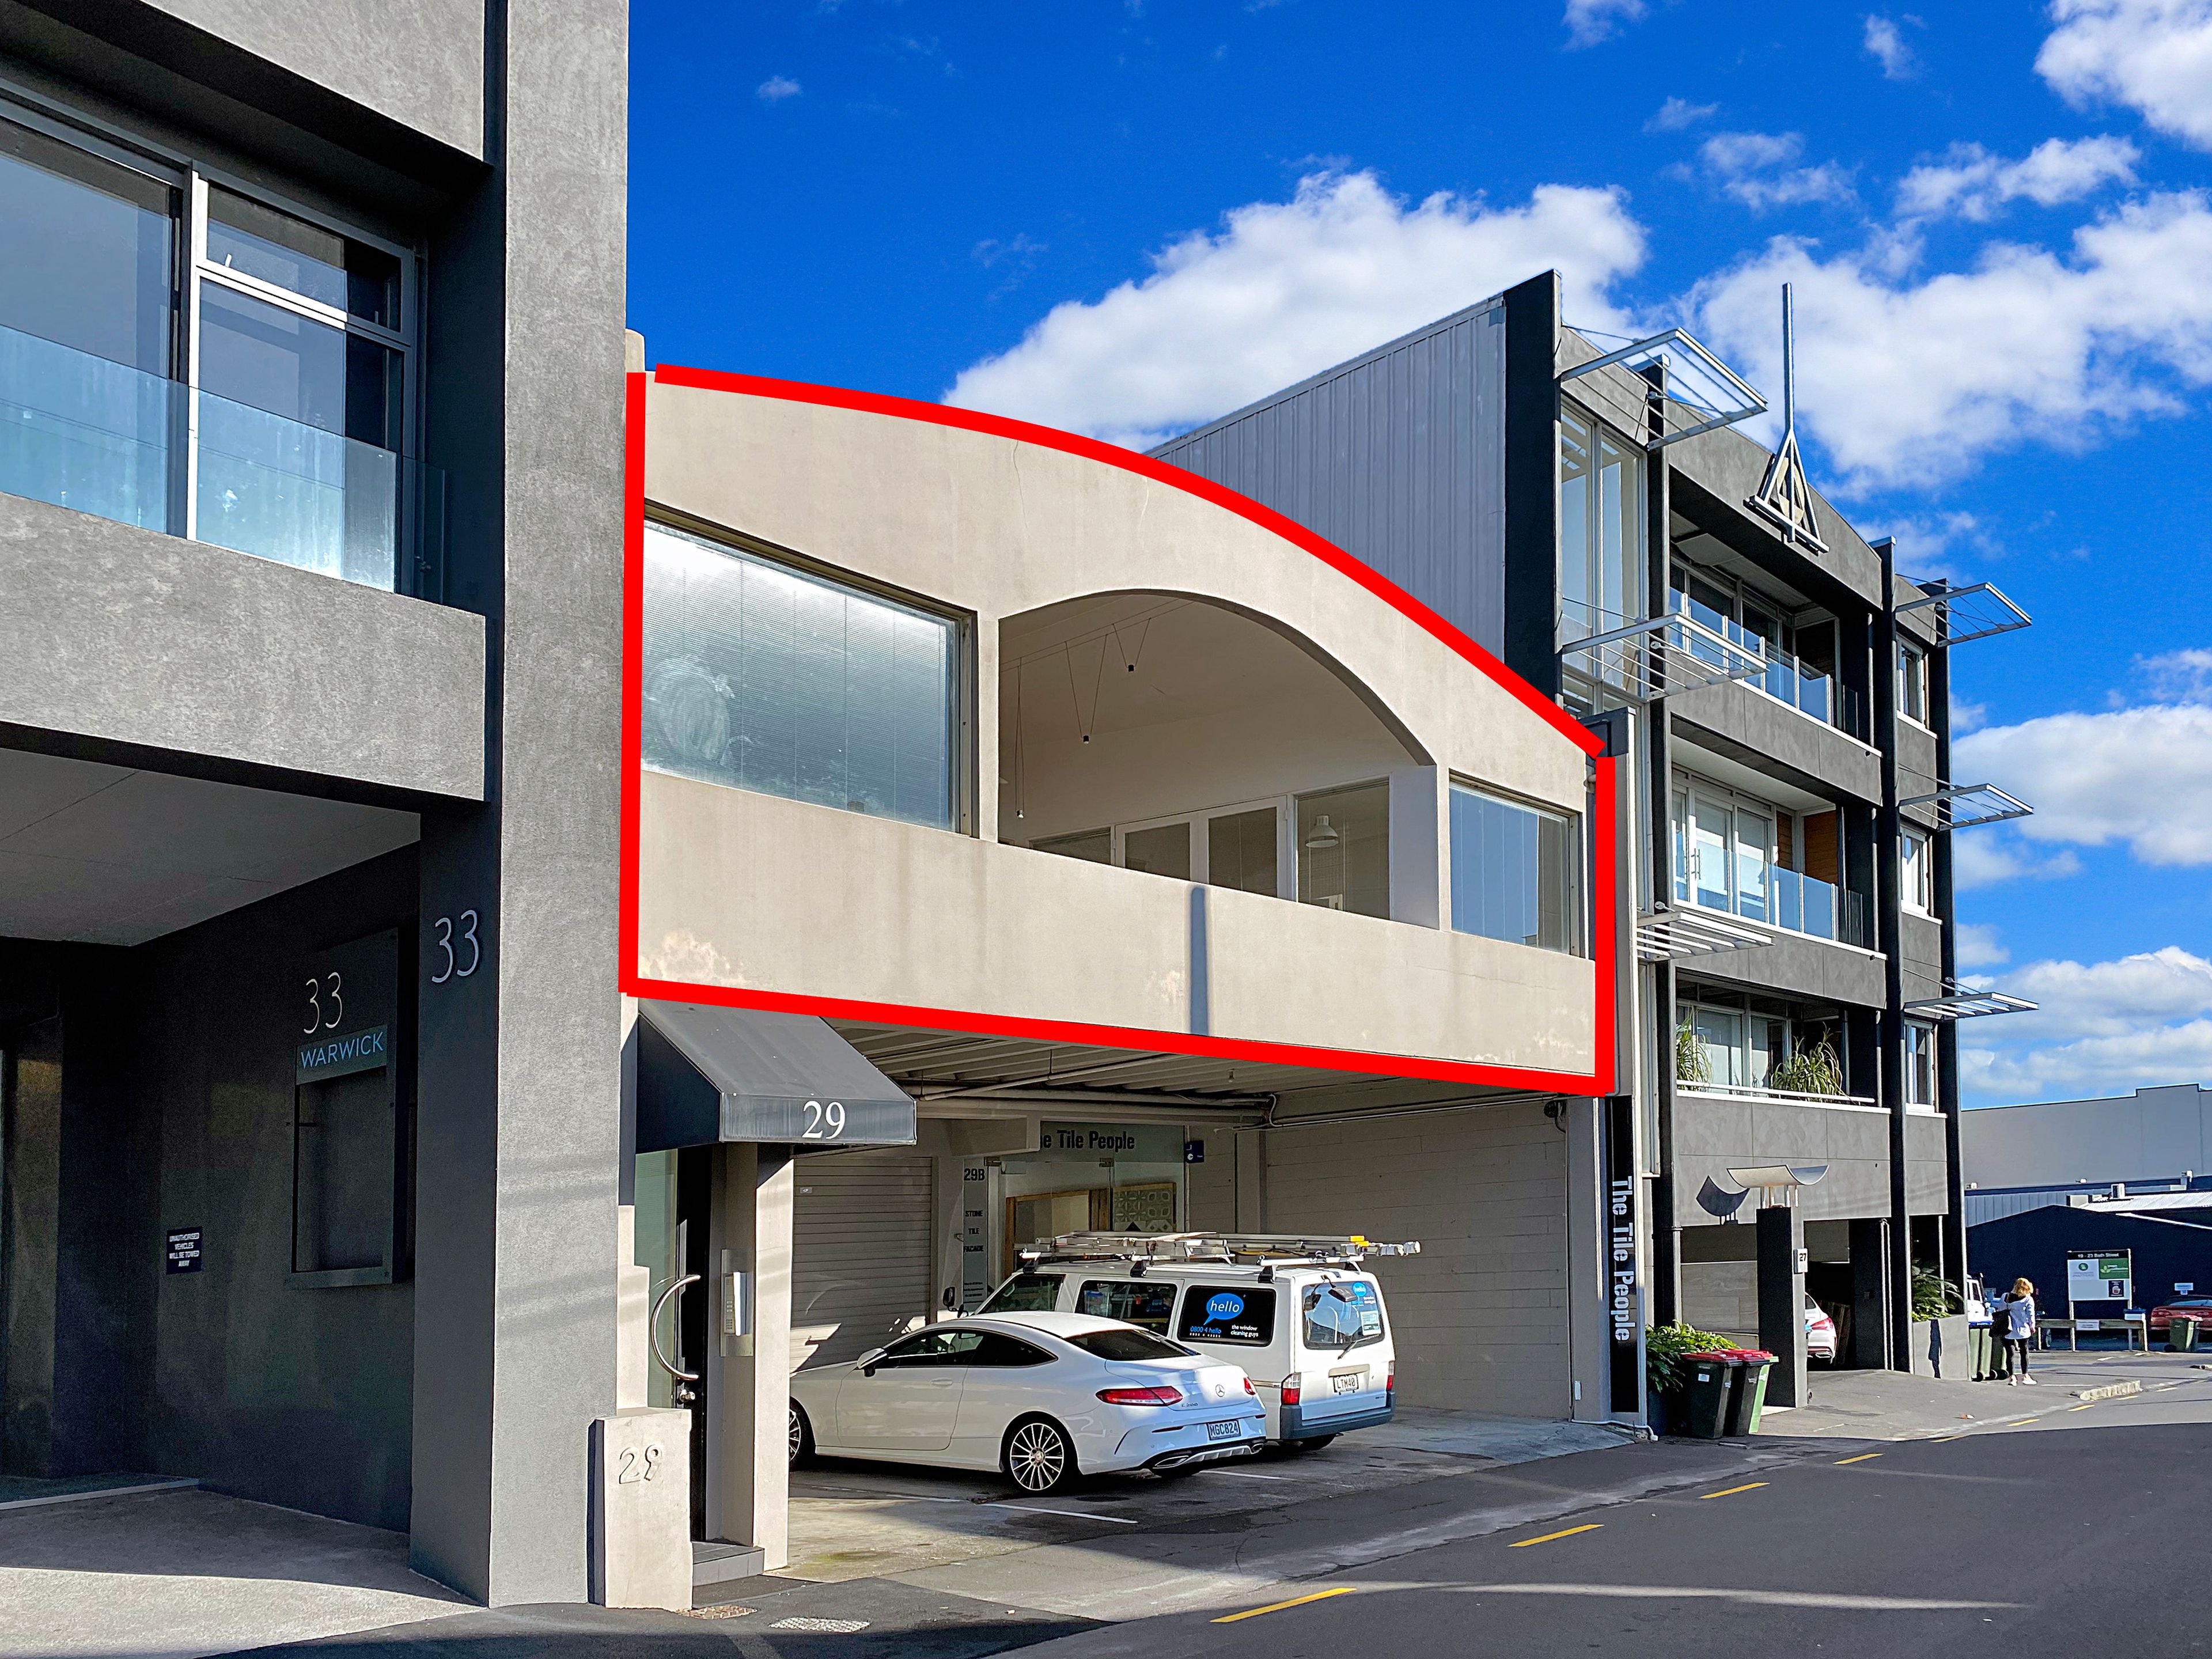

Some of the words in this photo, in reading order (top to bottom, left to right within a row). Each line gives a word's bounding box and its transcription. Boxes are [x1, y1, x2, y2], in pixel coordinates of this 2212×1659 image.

[432, 910, 479, 983] 33
[304, 972, 342, 1034] 33
[301, 1032, 383, 1069] WARWICK
[802, 1100, 846, 1139] 29
[1056, 1130, 1084, 1149] Tile
[1089, 1130, 1135, 1153] People
[964, 1168, 985, 1181] 29B
[1612, 1176, 1633, 1215] The
[1613, 1222, 1634, 1262] Tile
[1799, 1253, 1806, 1262] 27
[1210, 1300, 1240, 1312] hello
[1611, 1271, 1635, 1341] People
[1210, 1422, 1238, 1436] MGC824
